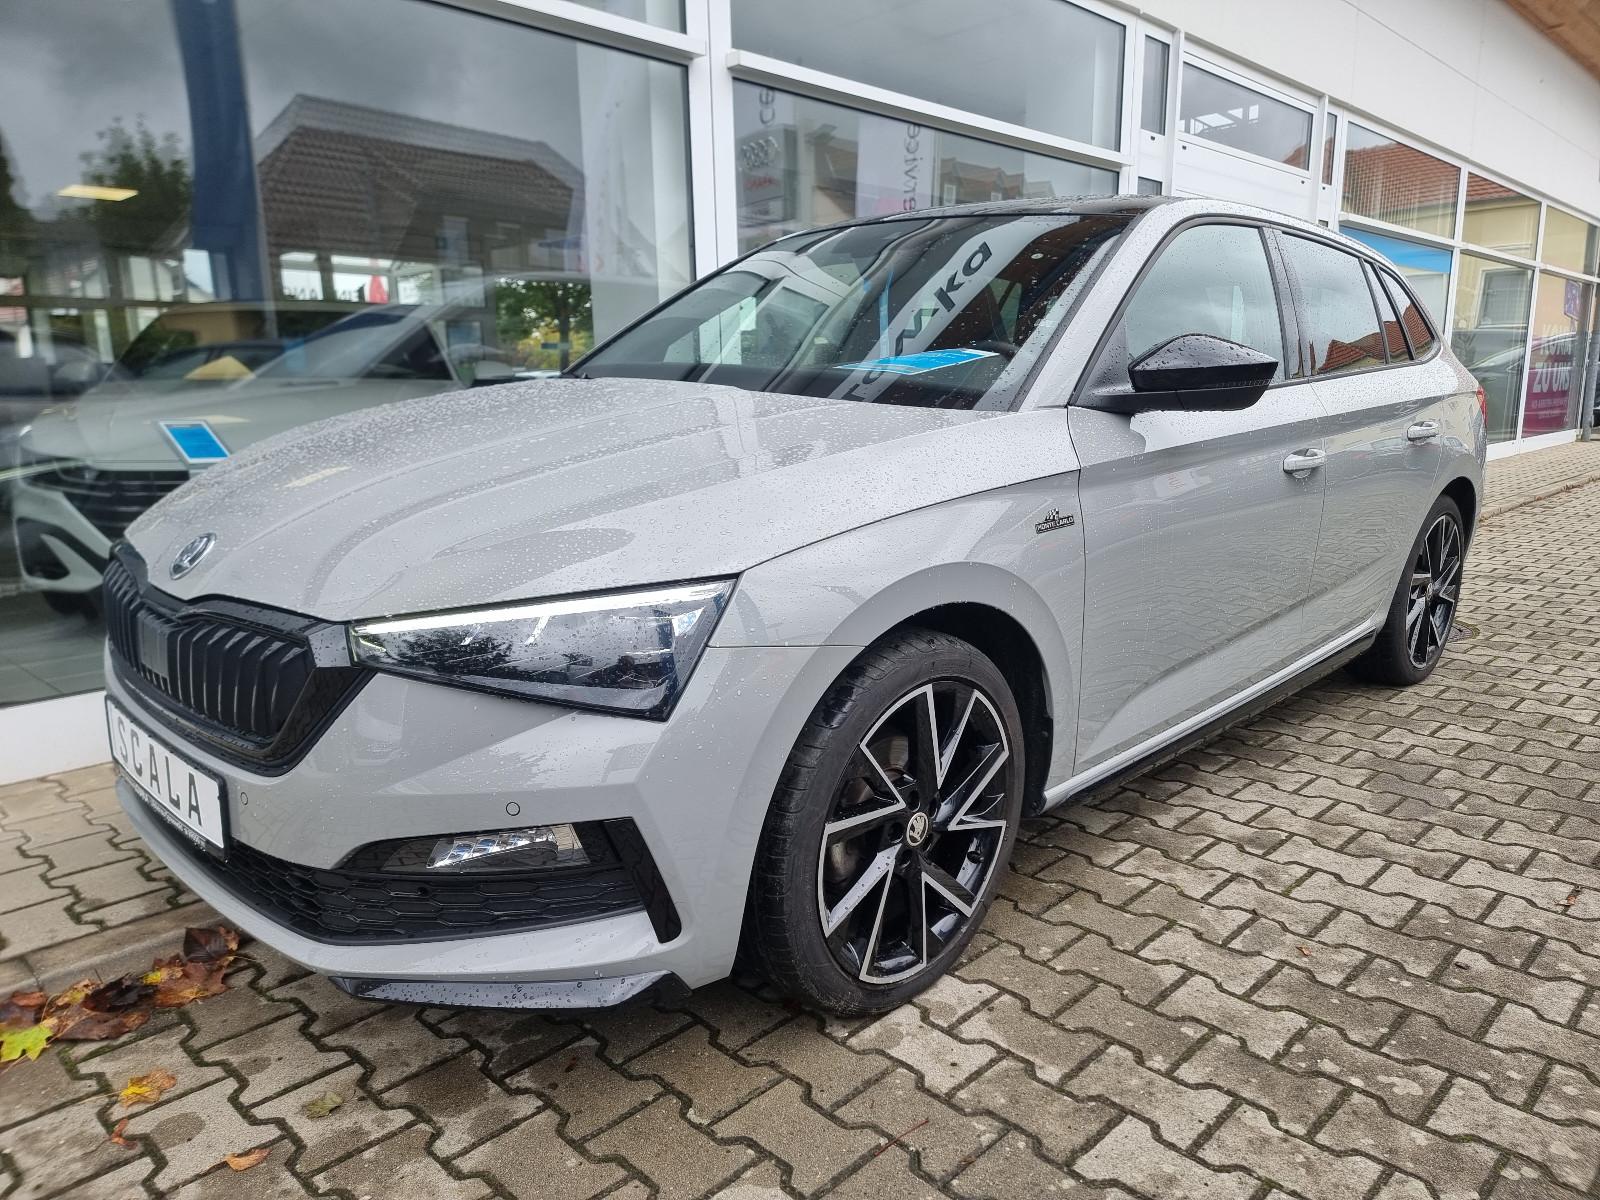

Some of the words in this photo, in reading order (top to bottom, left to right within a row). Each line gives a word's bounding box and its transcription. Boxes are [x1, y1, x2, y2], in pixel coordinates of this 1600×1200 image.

[1533, 362, 1551, 393] ZU
[1552, 362, 1572, 391] UNS
[1036, 521, 1056, 531] MONTE
[1056, 516, 1074, 526] CARLO
[117, 716, 203, 827] SCALA
